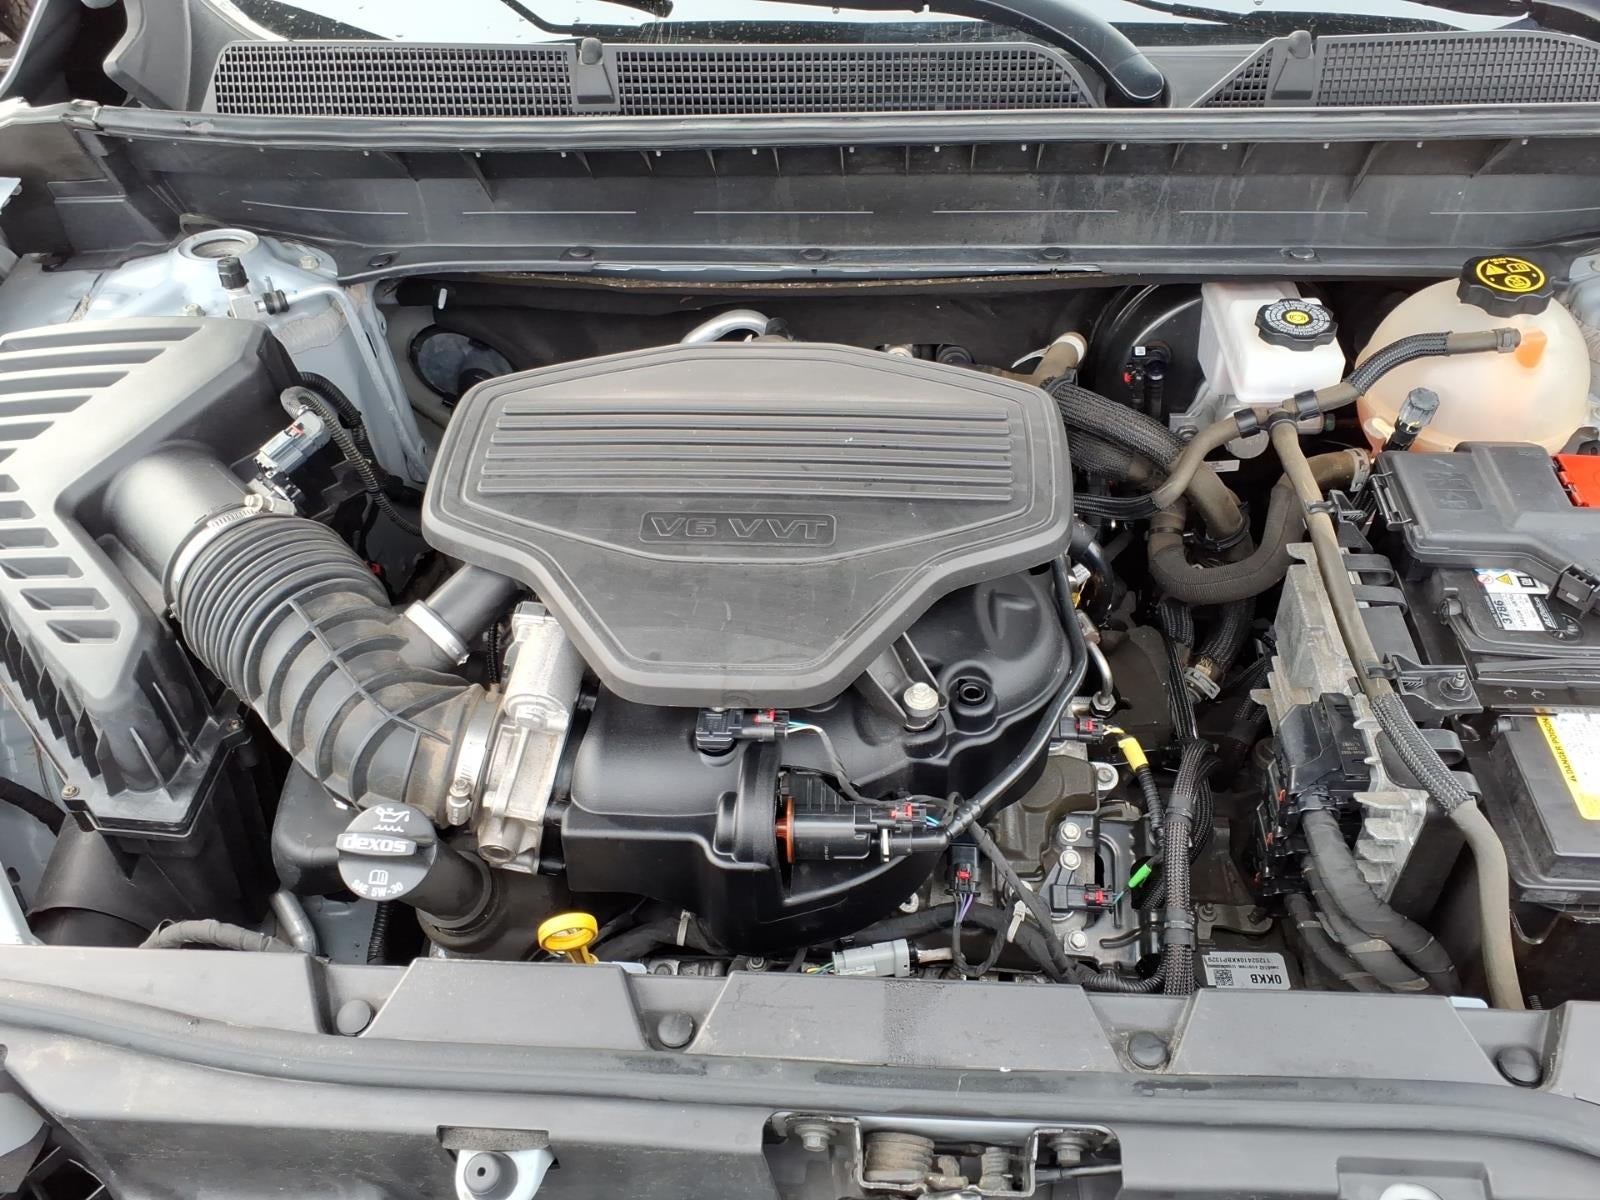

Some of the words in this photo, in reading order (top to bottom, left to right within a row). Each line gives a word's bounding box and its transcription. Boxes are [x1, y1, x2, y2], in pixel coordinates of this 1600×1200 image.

[651, 517, 717, 537] V6
[728, 518, 828, 540] VVT
[1542, 717, 1560, 745] POISON
[1555, 745, 1575, 776] DANGER
[342, 833, 409, 853] dexos
[371, 882, 404, 897] 5W-30
